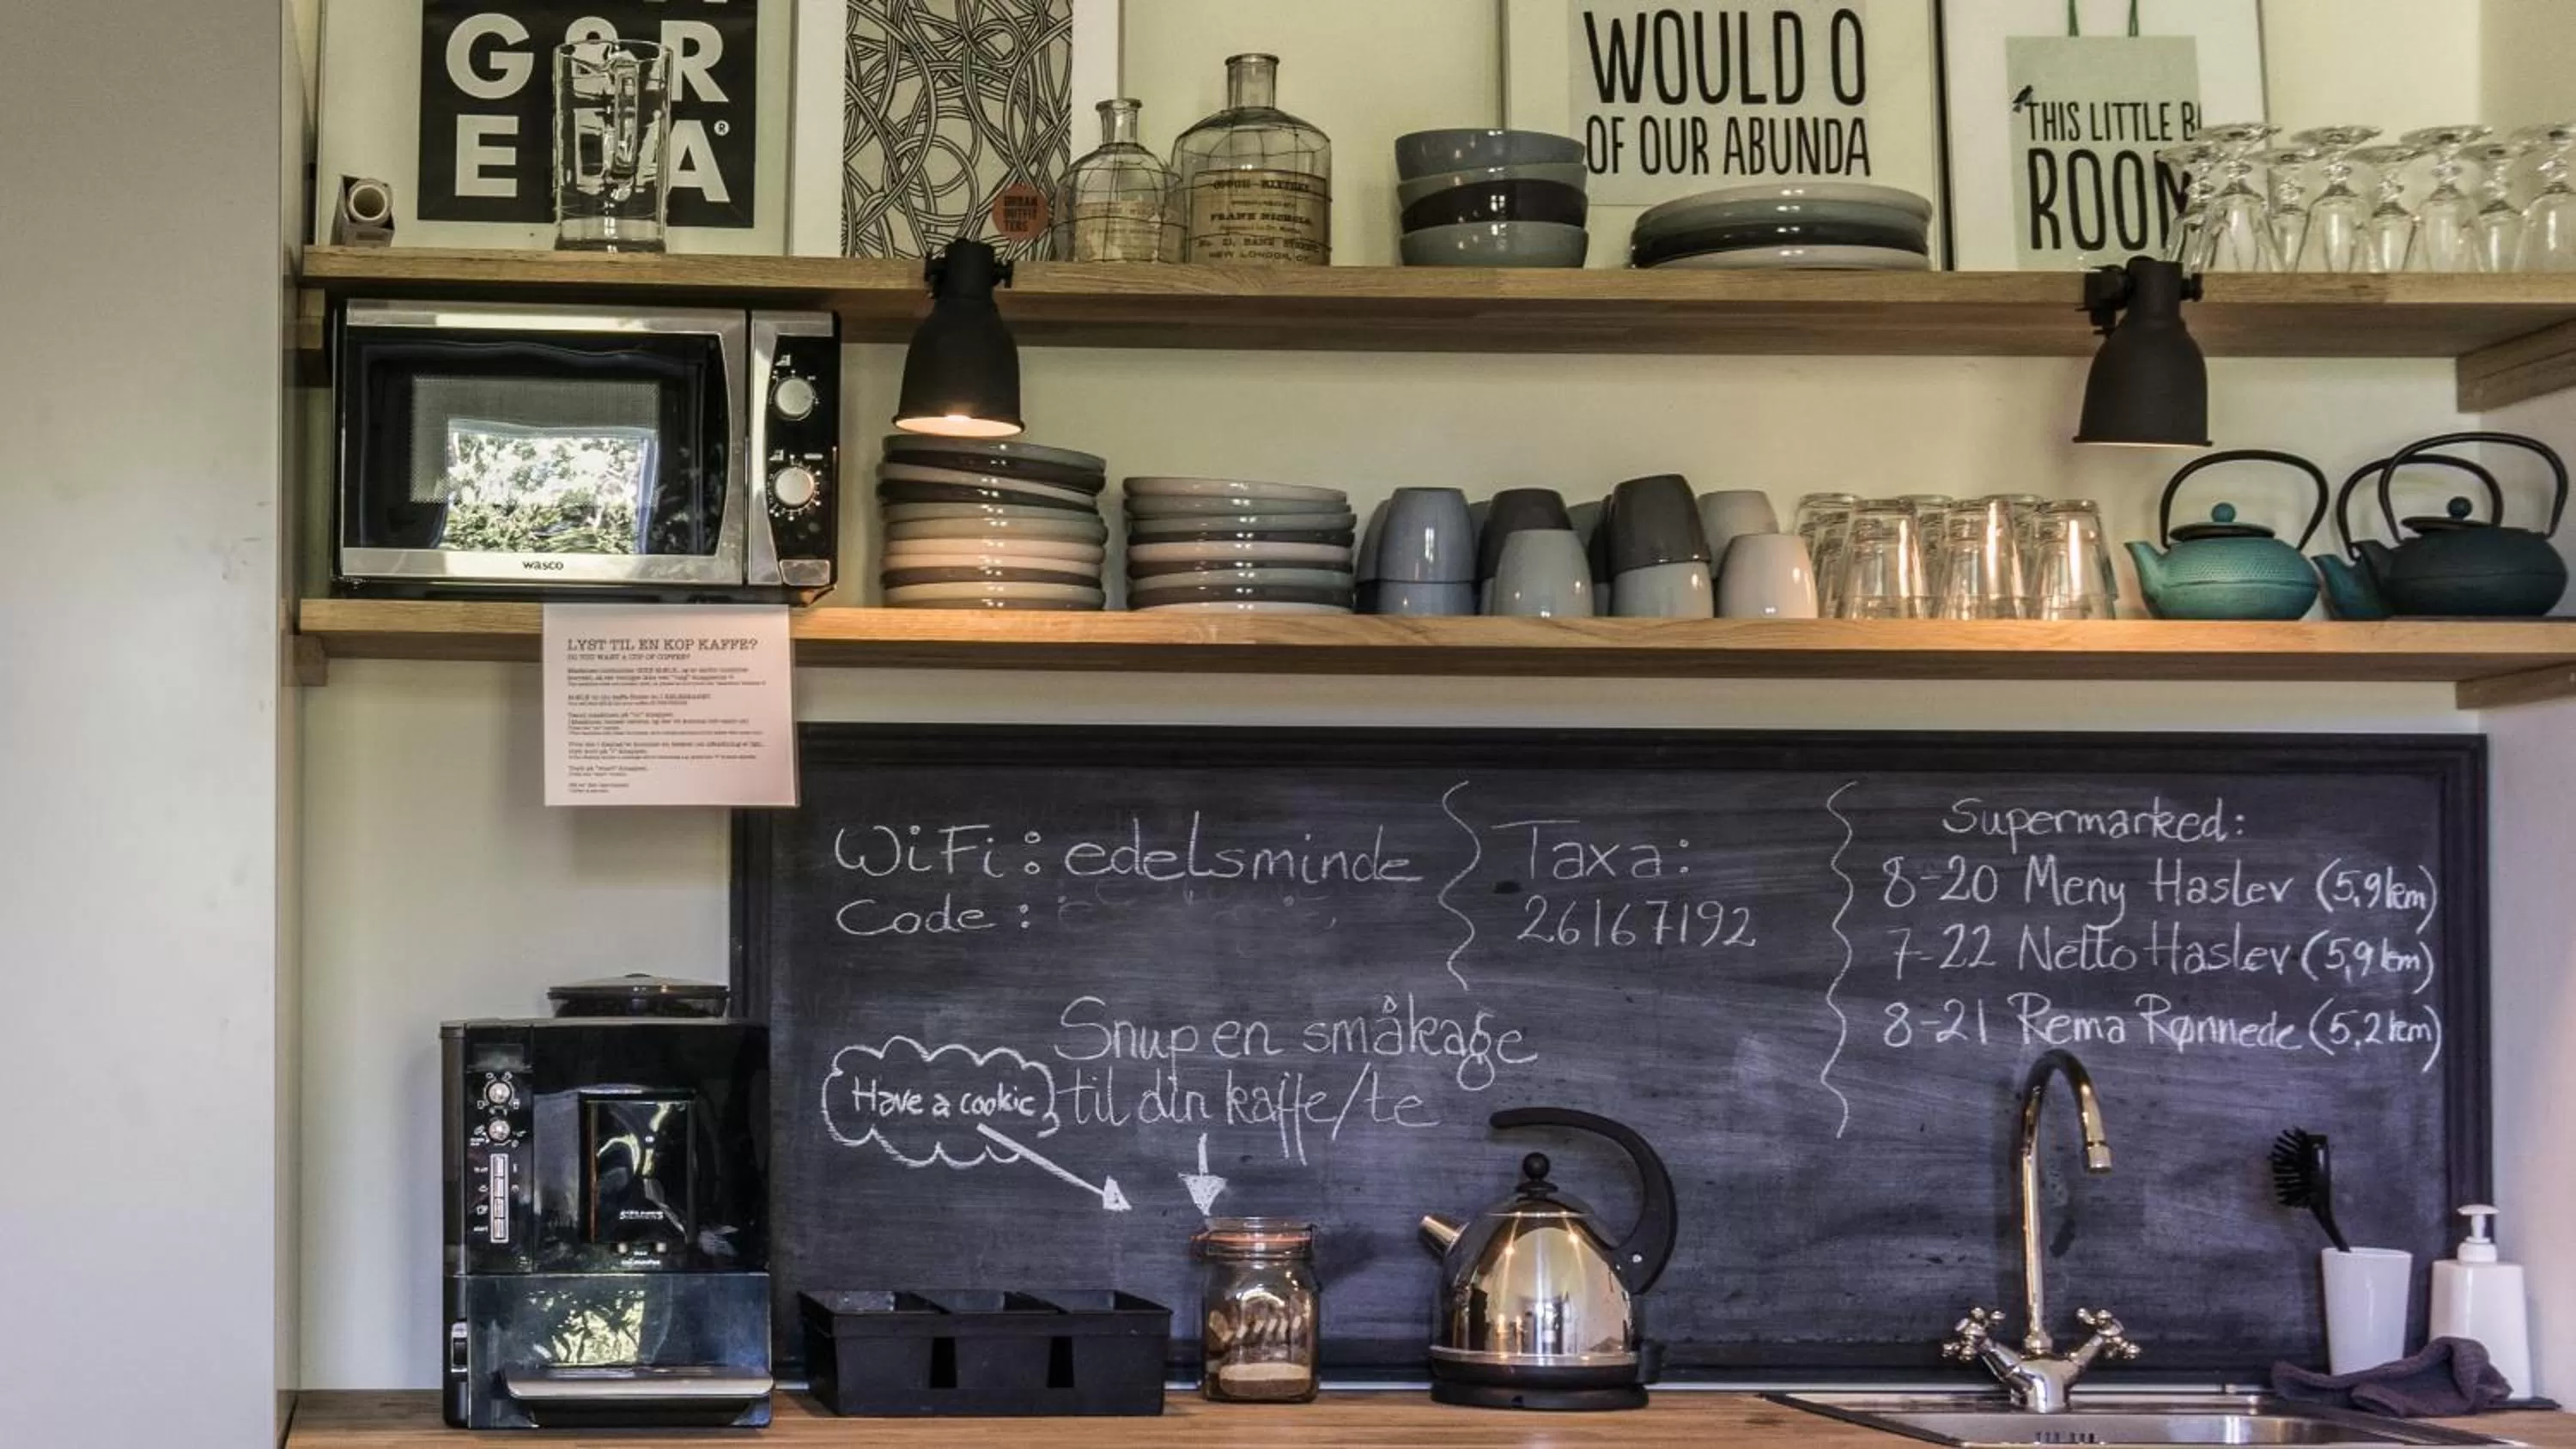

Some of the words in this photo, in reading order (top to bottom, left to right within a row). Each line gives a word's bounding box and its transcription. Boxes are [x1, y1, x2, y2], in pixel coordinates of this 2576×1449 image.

[1583, 9, 1805, 106] WOULD
[1586, 114, 1625, 175] OF
[1639, 115, 1710, 176] OUR
[1722, 116, 1872, 177] ABUNDA
[2025, 100, 2081, 142] THIS
[2090, 100, 2173, 142] LITTLE
[521, 560, 564, 571] wasco
[567, 638, 606, 651] LYST
[609, 638, 635, 651] TIL
[638, 638, 659, 651] EN
[664, 638, 695, 651] KOP
[698, 638, 758, 651] KAFFE?
[1064, 810, 1424, 884] edelsminde
[1942, 797, 2245, 855] Supermarked:
[1517, 894, 1757, 948] 26167192
[1882, 854, 1998, 907] 8-20
[2024, 853, 2126, 930] Meny
[2147, 858, 2295, 907] Haslev
[1888, 923, 1997, 981] 7-22
[2019, 923, 2137, 972] Netto
[2143, 919, 2292, 976] Haslev
[1054, 996, 1200, 1080] Snup
[1212, 1020, 1285, 1059] en
[1883, 997, 1989, 1047] 8-21
[2006, 991, 2127, 1045] Rema
[851, 1076, 924, 1117] Have
[932, 1093, 951, 1119] a
[959, 1082, 1036, 1117] cookie
[1056, 1065, 1131, 1126] til
[1138, 1067, 1212, 1124] din
